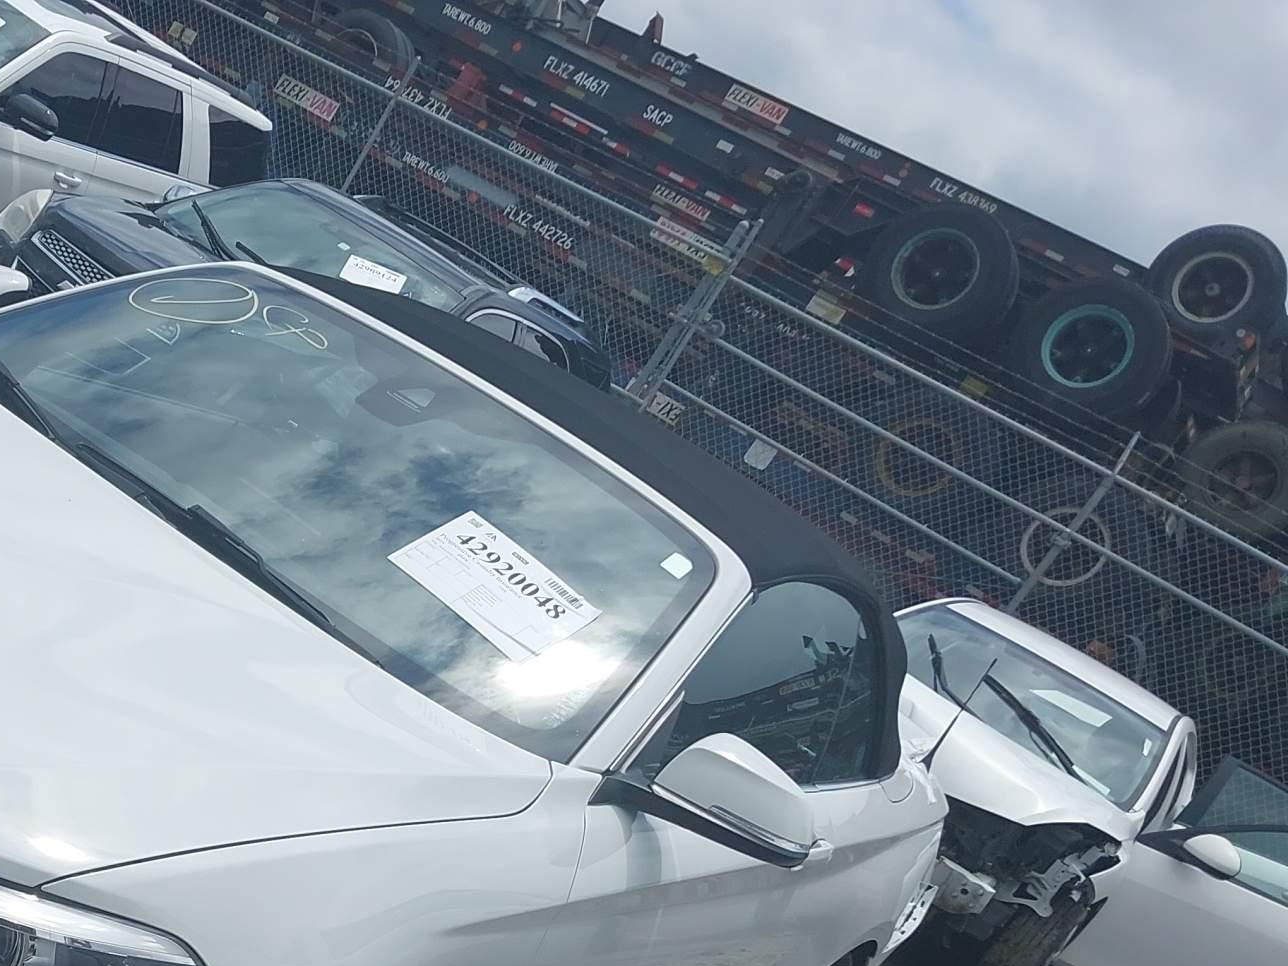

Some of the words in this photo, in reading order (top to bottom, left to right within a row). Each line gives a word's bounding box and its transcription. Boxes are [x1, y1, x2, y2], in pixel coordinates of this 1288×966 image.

[384, 75, 425, 104] 43764
[544, 56, 576, 80] FLXZ
[573, 69, 610, 98] 414671
[275, 78, 337, 121] FLEXI-VAN
[642, 104, 673, 127] SACP
[727, 84, 787, 124] FLEXI-VAN
[929, 177, 960, 199] FLXZ
[503, 204, 531, 229] FLXZ
[531, 219, 574, 251] 442726
[456, 533, 567, 620] 42920048
